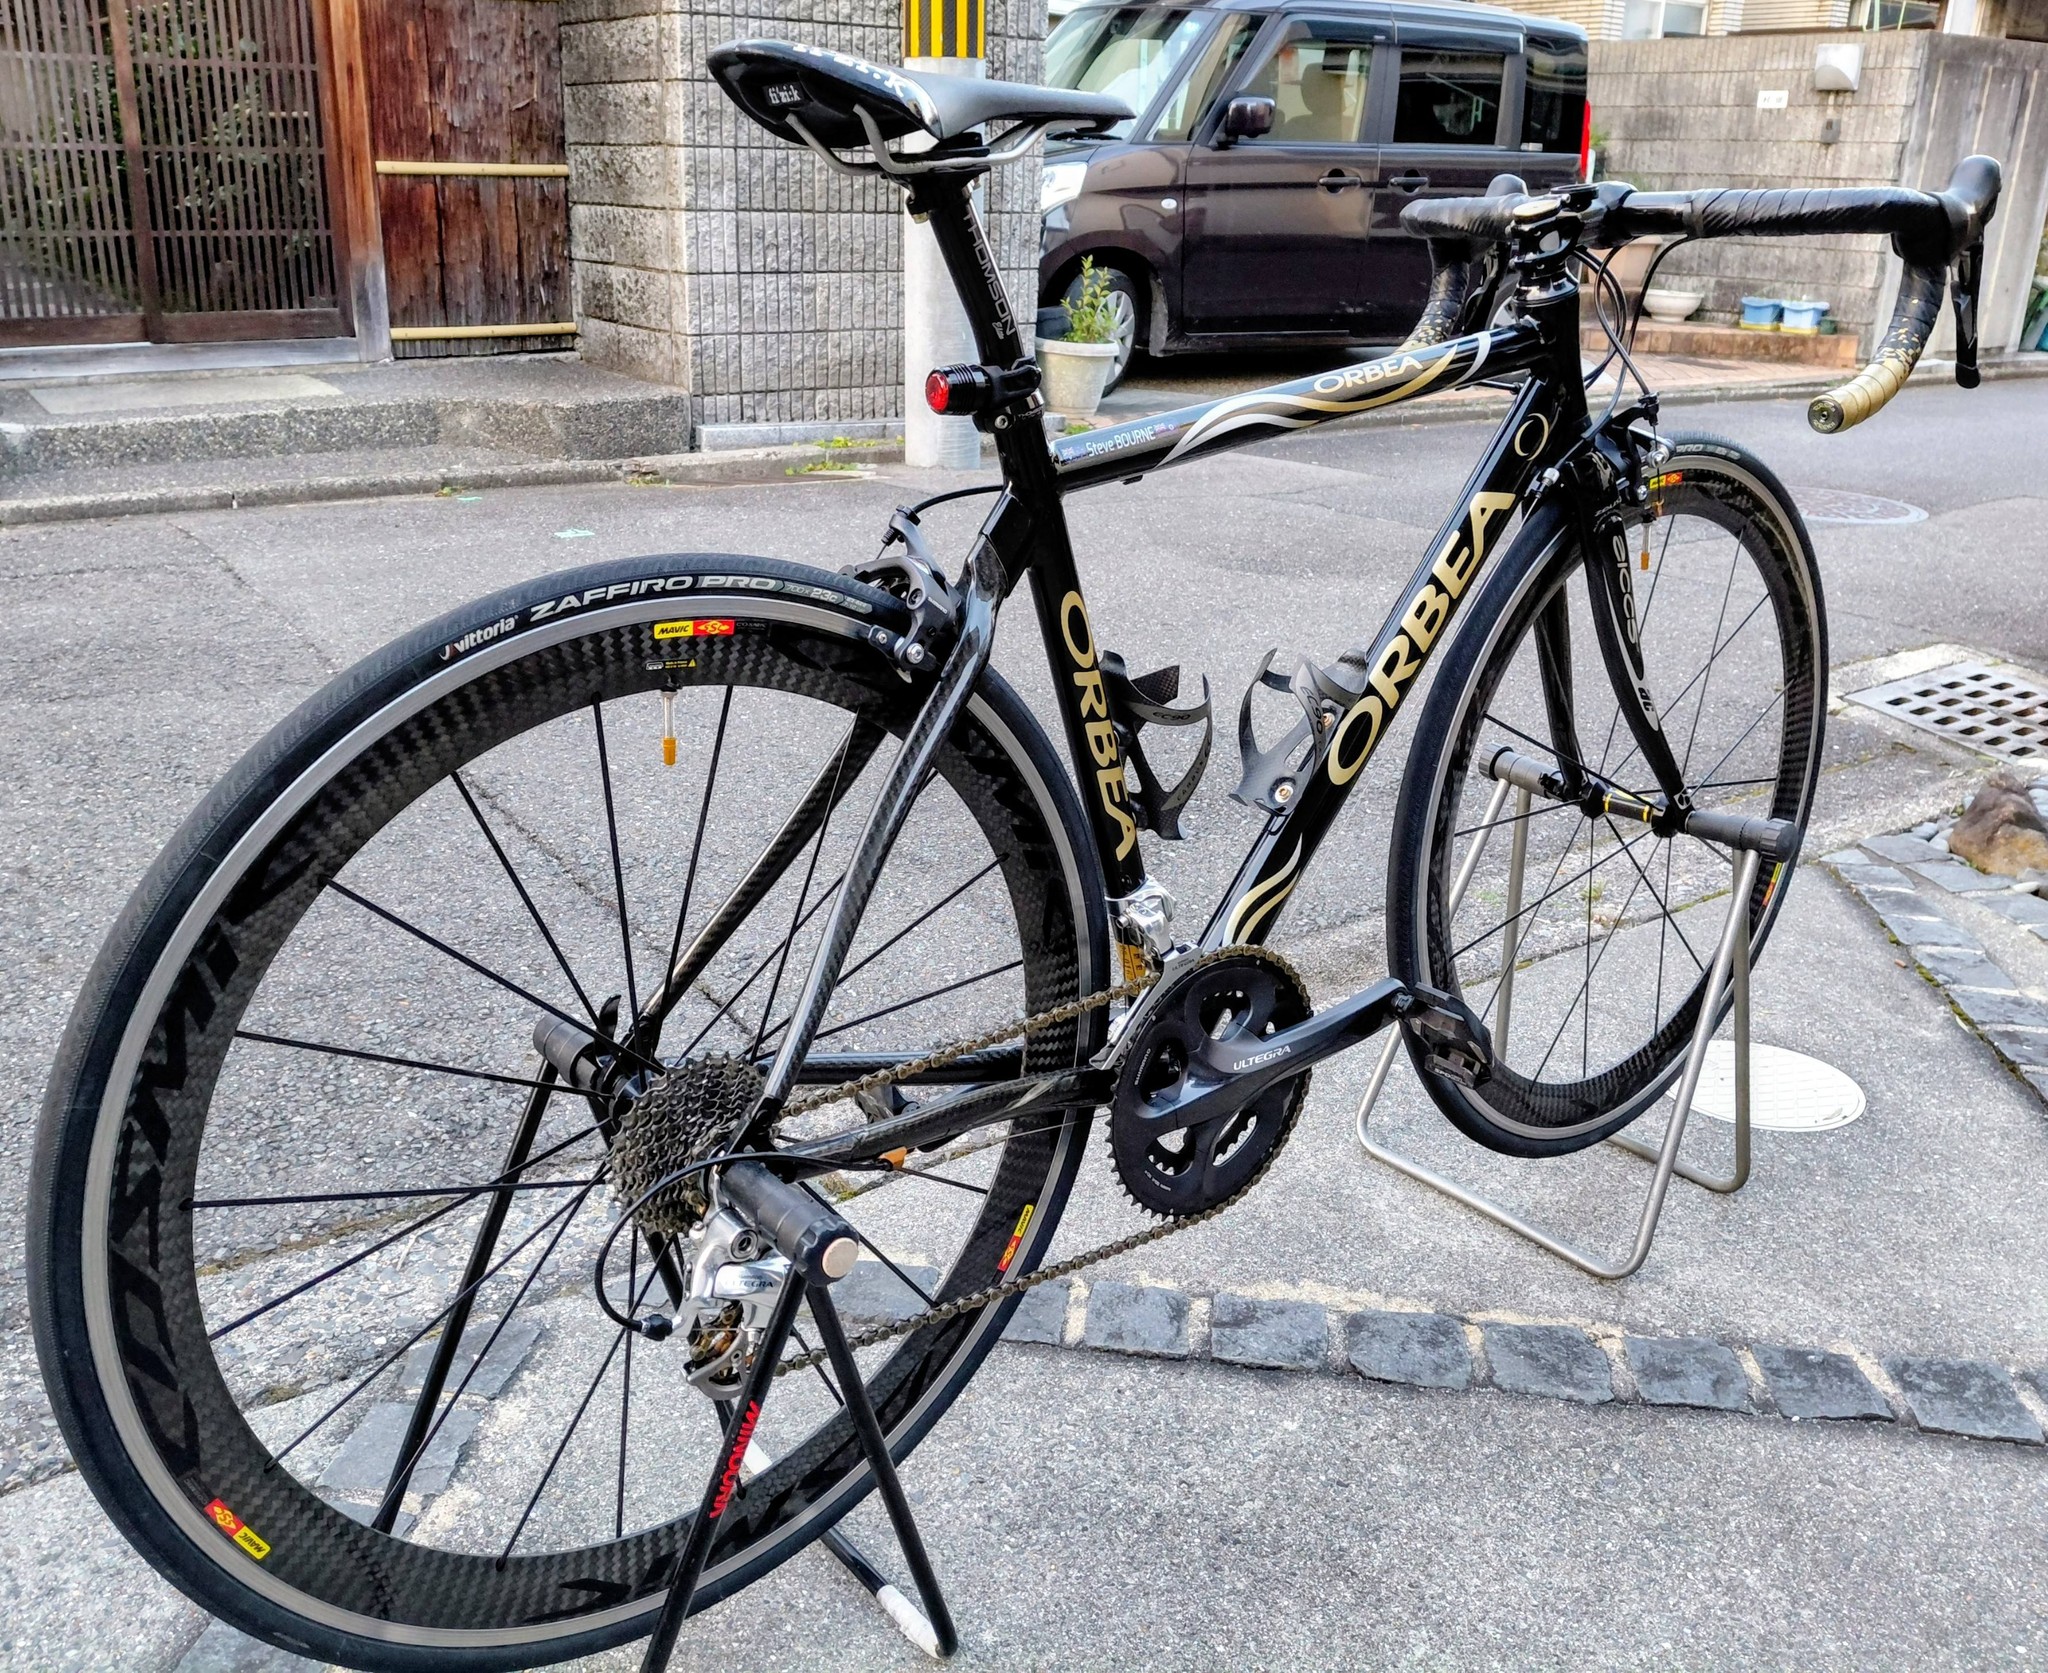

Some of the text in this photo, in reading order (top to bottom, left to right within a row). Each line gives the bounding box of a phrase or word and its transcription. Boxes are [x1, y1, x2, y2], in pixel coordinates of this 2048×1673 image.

[963, 206, 1017, 336] THOMSON
[1313, 355, 1424, 394] ORBEA
[1086, 426, 1156, 457] Steve BOURNE
[530, 576, 776, 622] ZAFFIRO PRO
[453, 616, 516, 653] vittoria
[658, 625, 689, 635] MAVIC
[1328, 491, 1516, 786] ORBEA
[1060, 590, 1136, 862] ORBEA
[1152, 710, 1191, 721] EC90
[1233, 1045, 1292, 1071] ULTEGRA
[1018, 1208, 1031, 1233] MAVIC
[725, 1280, 774, 1289] TEGRA
[709, 1400, 761, 1519] MINOURA
[239, 1532, 266, 1553] MAVIC
